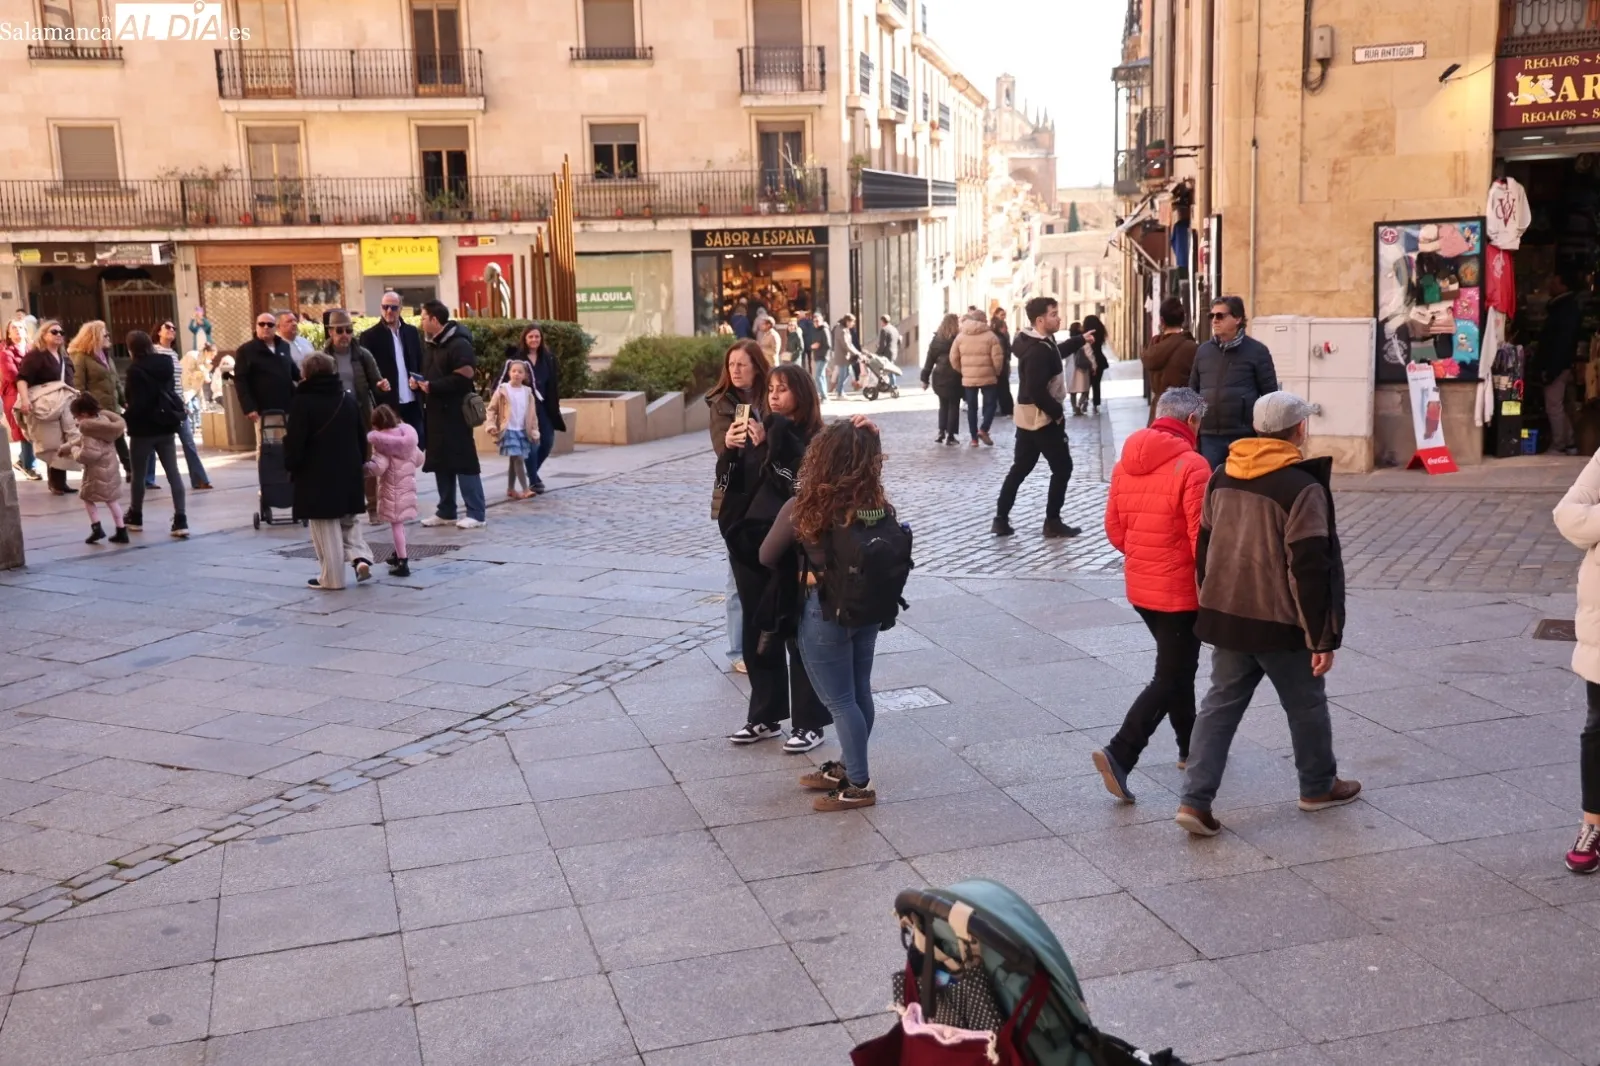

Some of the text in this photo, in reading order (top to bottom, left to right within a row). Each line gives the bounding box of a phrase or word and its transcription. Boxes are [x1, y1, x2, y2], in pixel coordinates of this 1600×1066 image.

[1364, 46, 1414, 59] RUA ANTIGUA
[1524, 55, 1580, 70] REGALOS
[1521, 109, 1577, 123] REGALOS
[705, 231, 750, 247] SABOR
[762, 229, 816, 246] ESPAÑA
[383, 244, 434, 255] EXPLORA
[589, 291, 633, 302] ALQUILA
